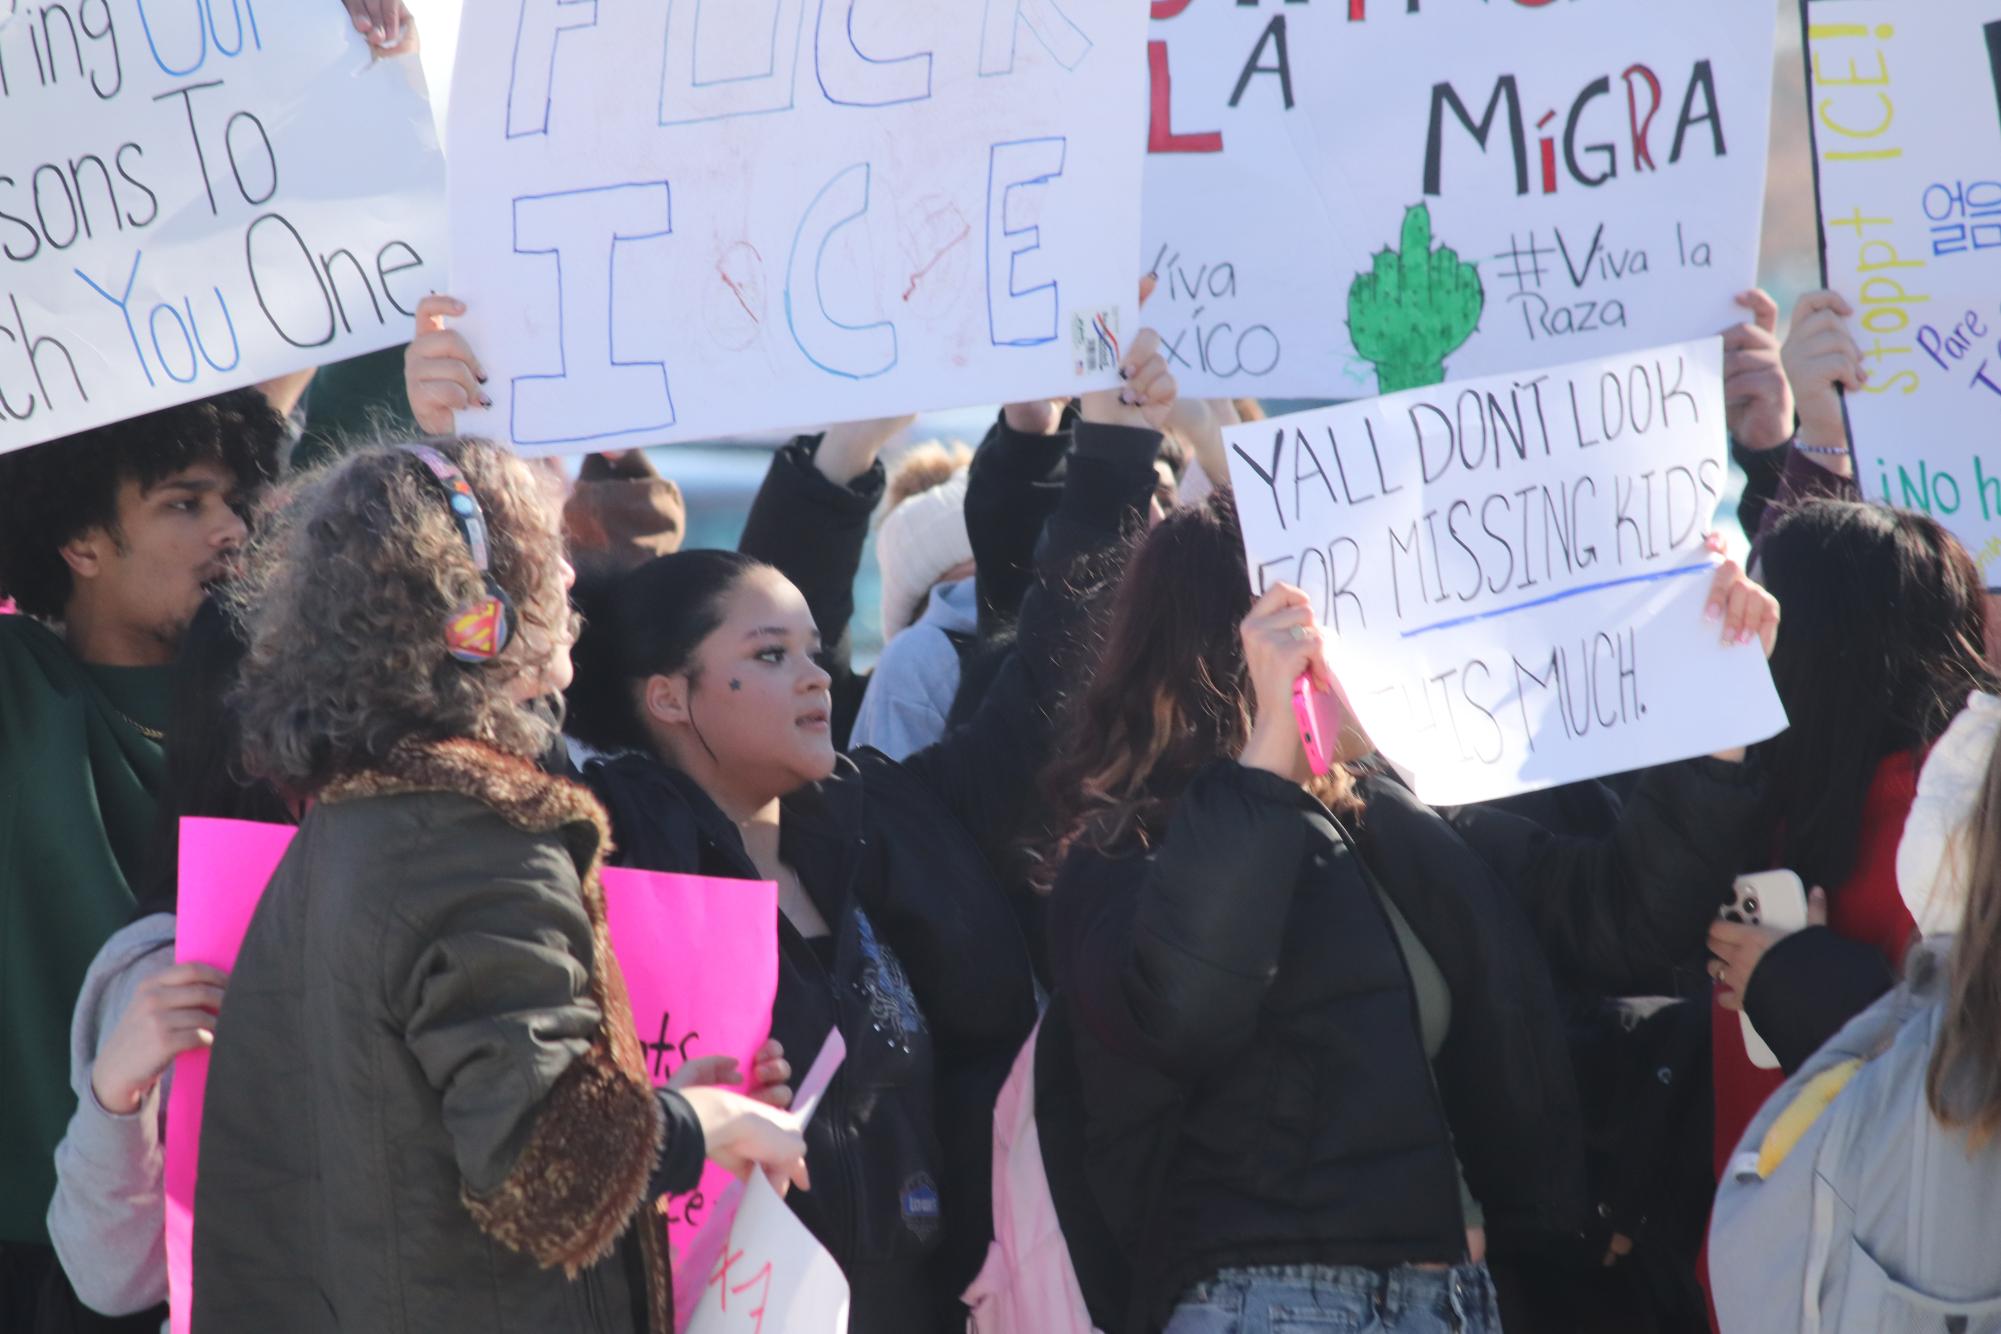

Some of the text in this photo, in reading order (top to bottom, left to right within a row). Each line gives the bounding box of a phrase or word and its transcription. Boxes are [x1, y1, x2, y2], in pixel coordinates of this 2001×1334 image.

[153, 80, 277, 216] To
[1147, 14, 1295, 154] LA
[1808, 23, 1902, 161] ICE!
[74, 249, 240, 387] You
[246, 213, 436, 348] One
[511, 135, 1066, 444] ICE
[1676, 222, 1711, 267] la
[1506, 291, 1627, 340] Raza
[1917, 309, 1988, 371] Pare
[1232, 418, 1402, 530] YALL
[1569, 356, 1699, 449] LOOK
[1388, 475, 1597, 618] MISSING
[1614, 458, 1720, 565] KIDS
[1512, 626, 1646, 752] MUCH.
